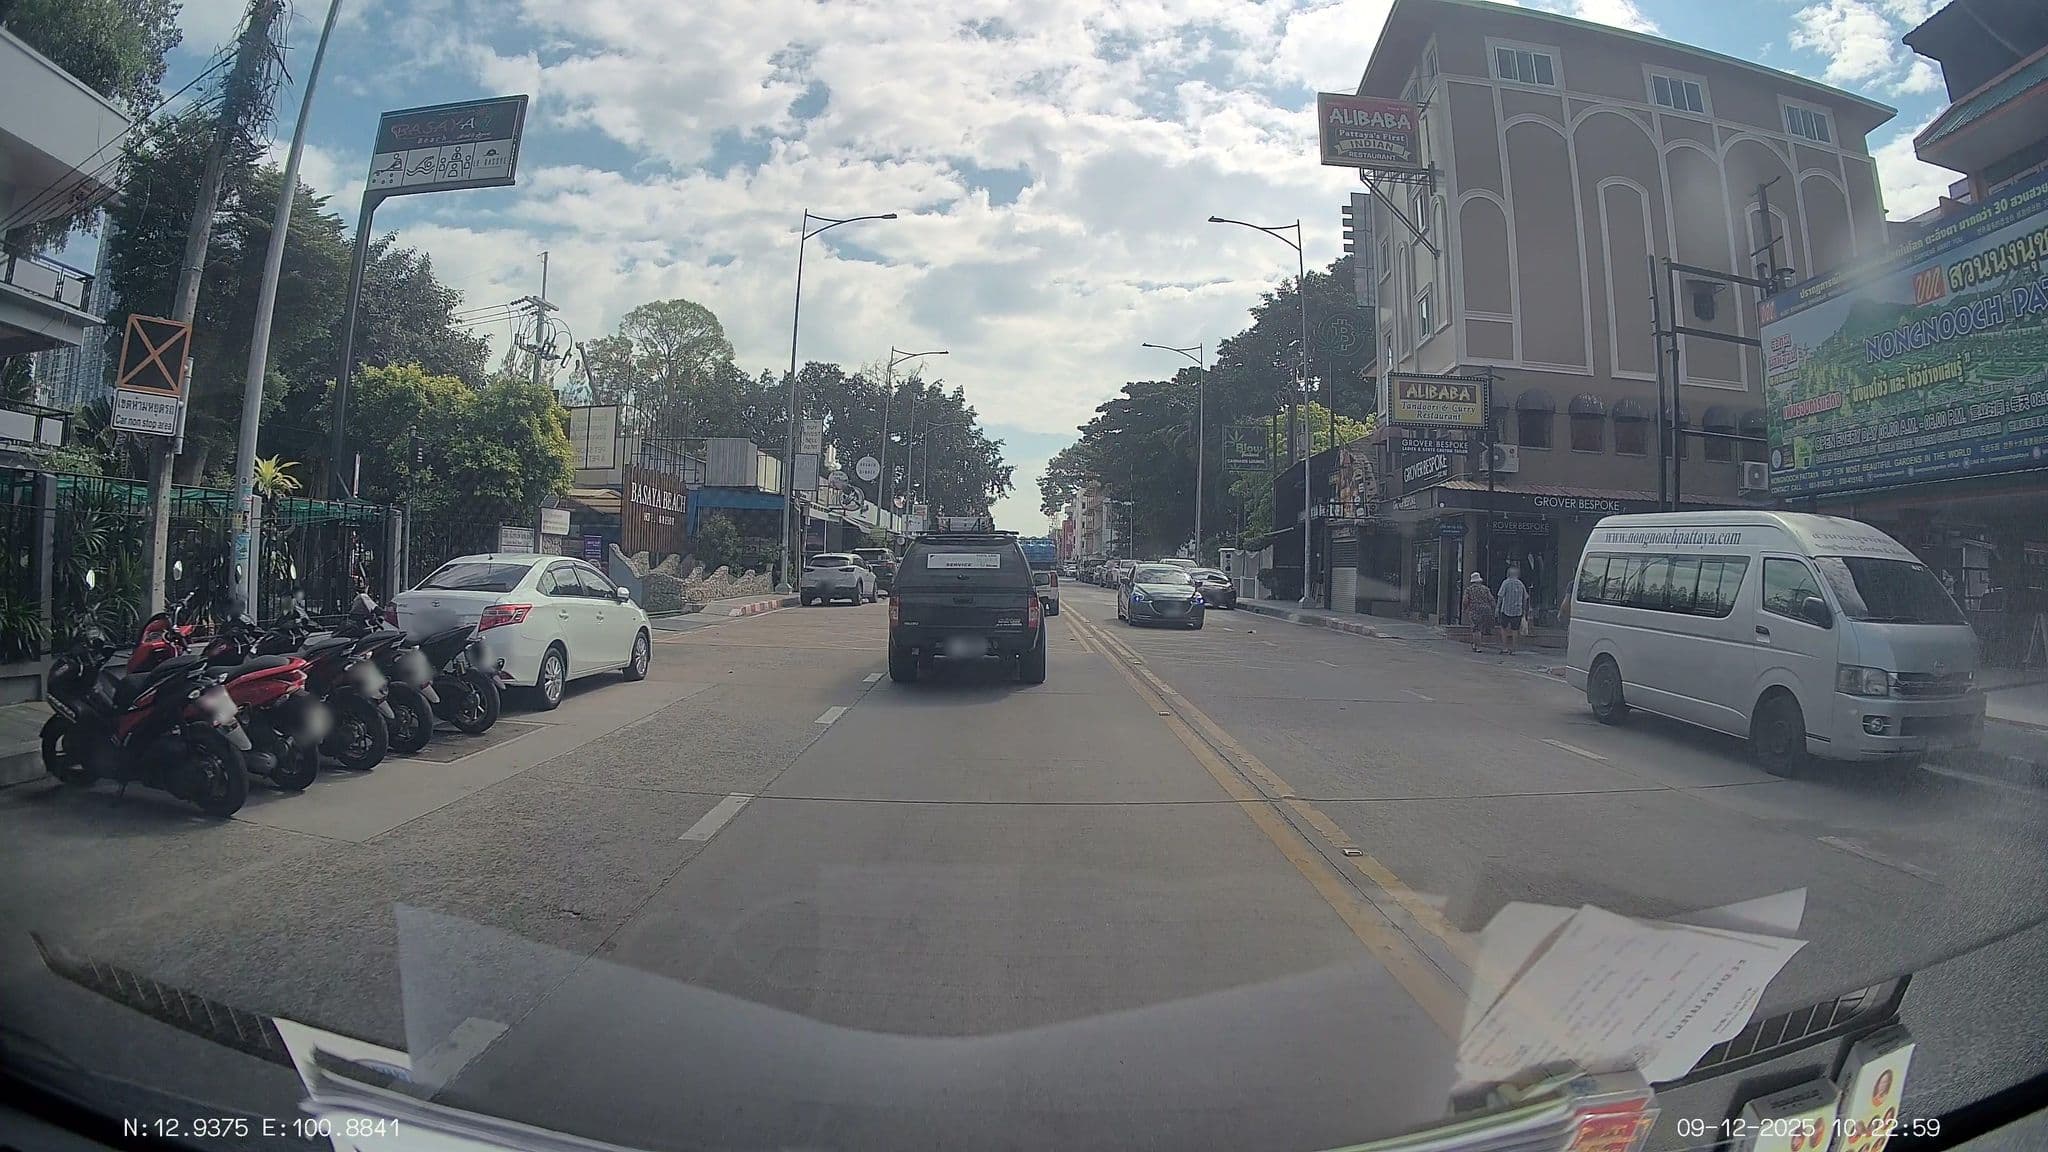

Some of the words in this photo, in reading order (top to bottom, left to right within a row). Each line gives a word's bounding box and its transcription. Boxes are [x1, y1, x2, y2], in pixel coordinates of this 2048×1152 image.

[1329, 108, 1412, 130] ALIBABA
[1339, 129, 1380, 140] Pattaya's
[1383, 133, 1405, 142] First
[1350, 140, 1394, 152] INDIAN
[1348, 151, 1396, 161] RESTAURANT
[1994, 198, 2008, 214] 30
[1864, 294, 2005, 364] NONGNOOCH
[1406, 383, 1471, 401] ALIBABA
[1401, 401, 1439, 412] Tandoori
[1441, 403, 1448, 411] &
[1451, 403, 1476, 416] Curry
[1417, 411, 1462, 421] Restaurant
[115, 414, 128, 425] Car
[128, 417, 141, 426] non
[142, 418, 157, 429] stop
[158, 421, 172, 431] area
[1402, 439, 1433, 448] GROVER
[1436, 440, 1469, 449] BESPOKE
[1815, 433, 1836, 451] OPEN
[1836, 428, 1861, 448] EVERY
[1861, 426, 1878, 442] DAY
[1948, 447, 1972, 458] WORLD
[630, 482, 661, 508] BASAYA
[663, 489, 687, 514] BEACH
[1533, 496, 1577, 510] GROVER
[1578, 498, 1620, 511] BESPOKE
[1604, 530, 1741, 550] www.nongnoochpattaya.com
